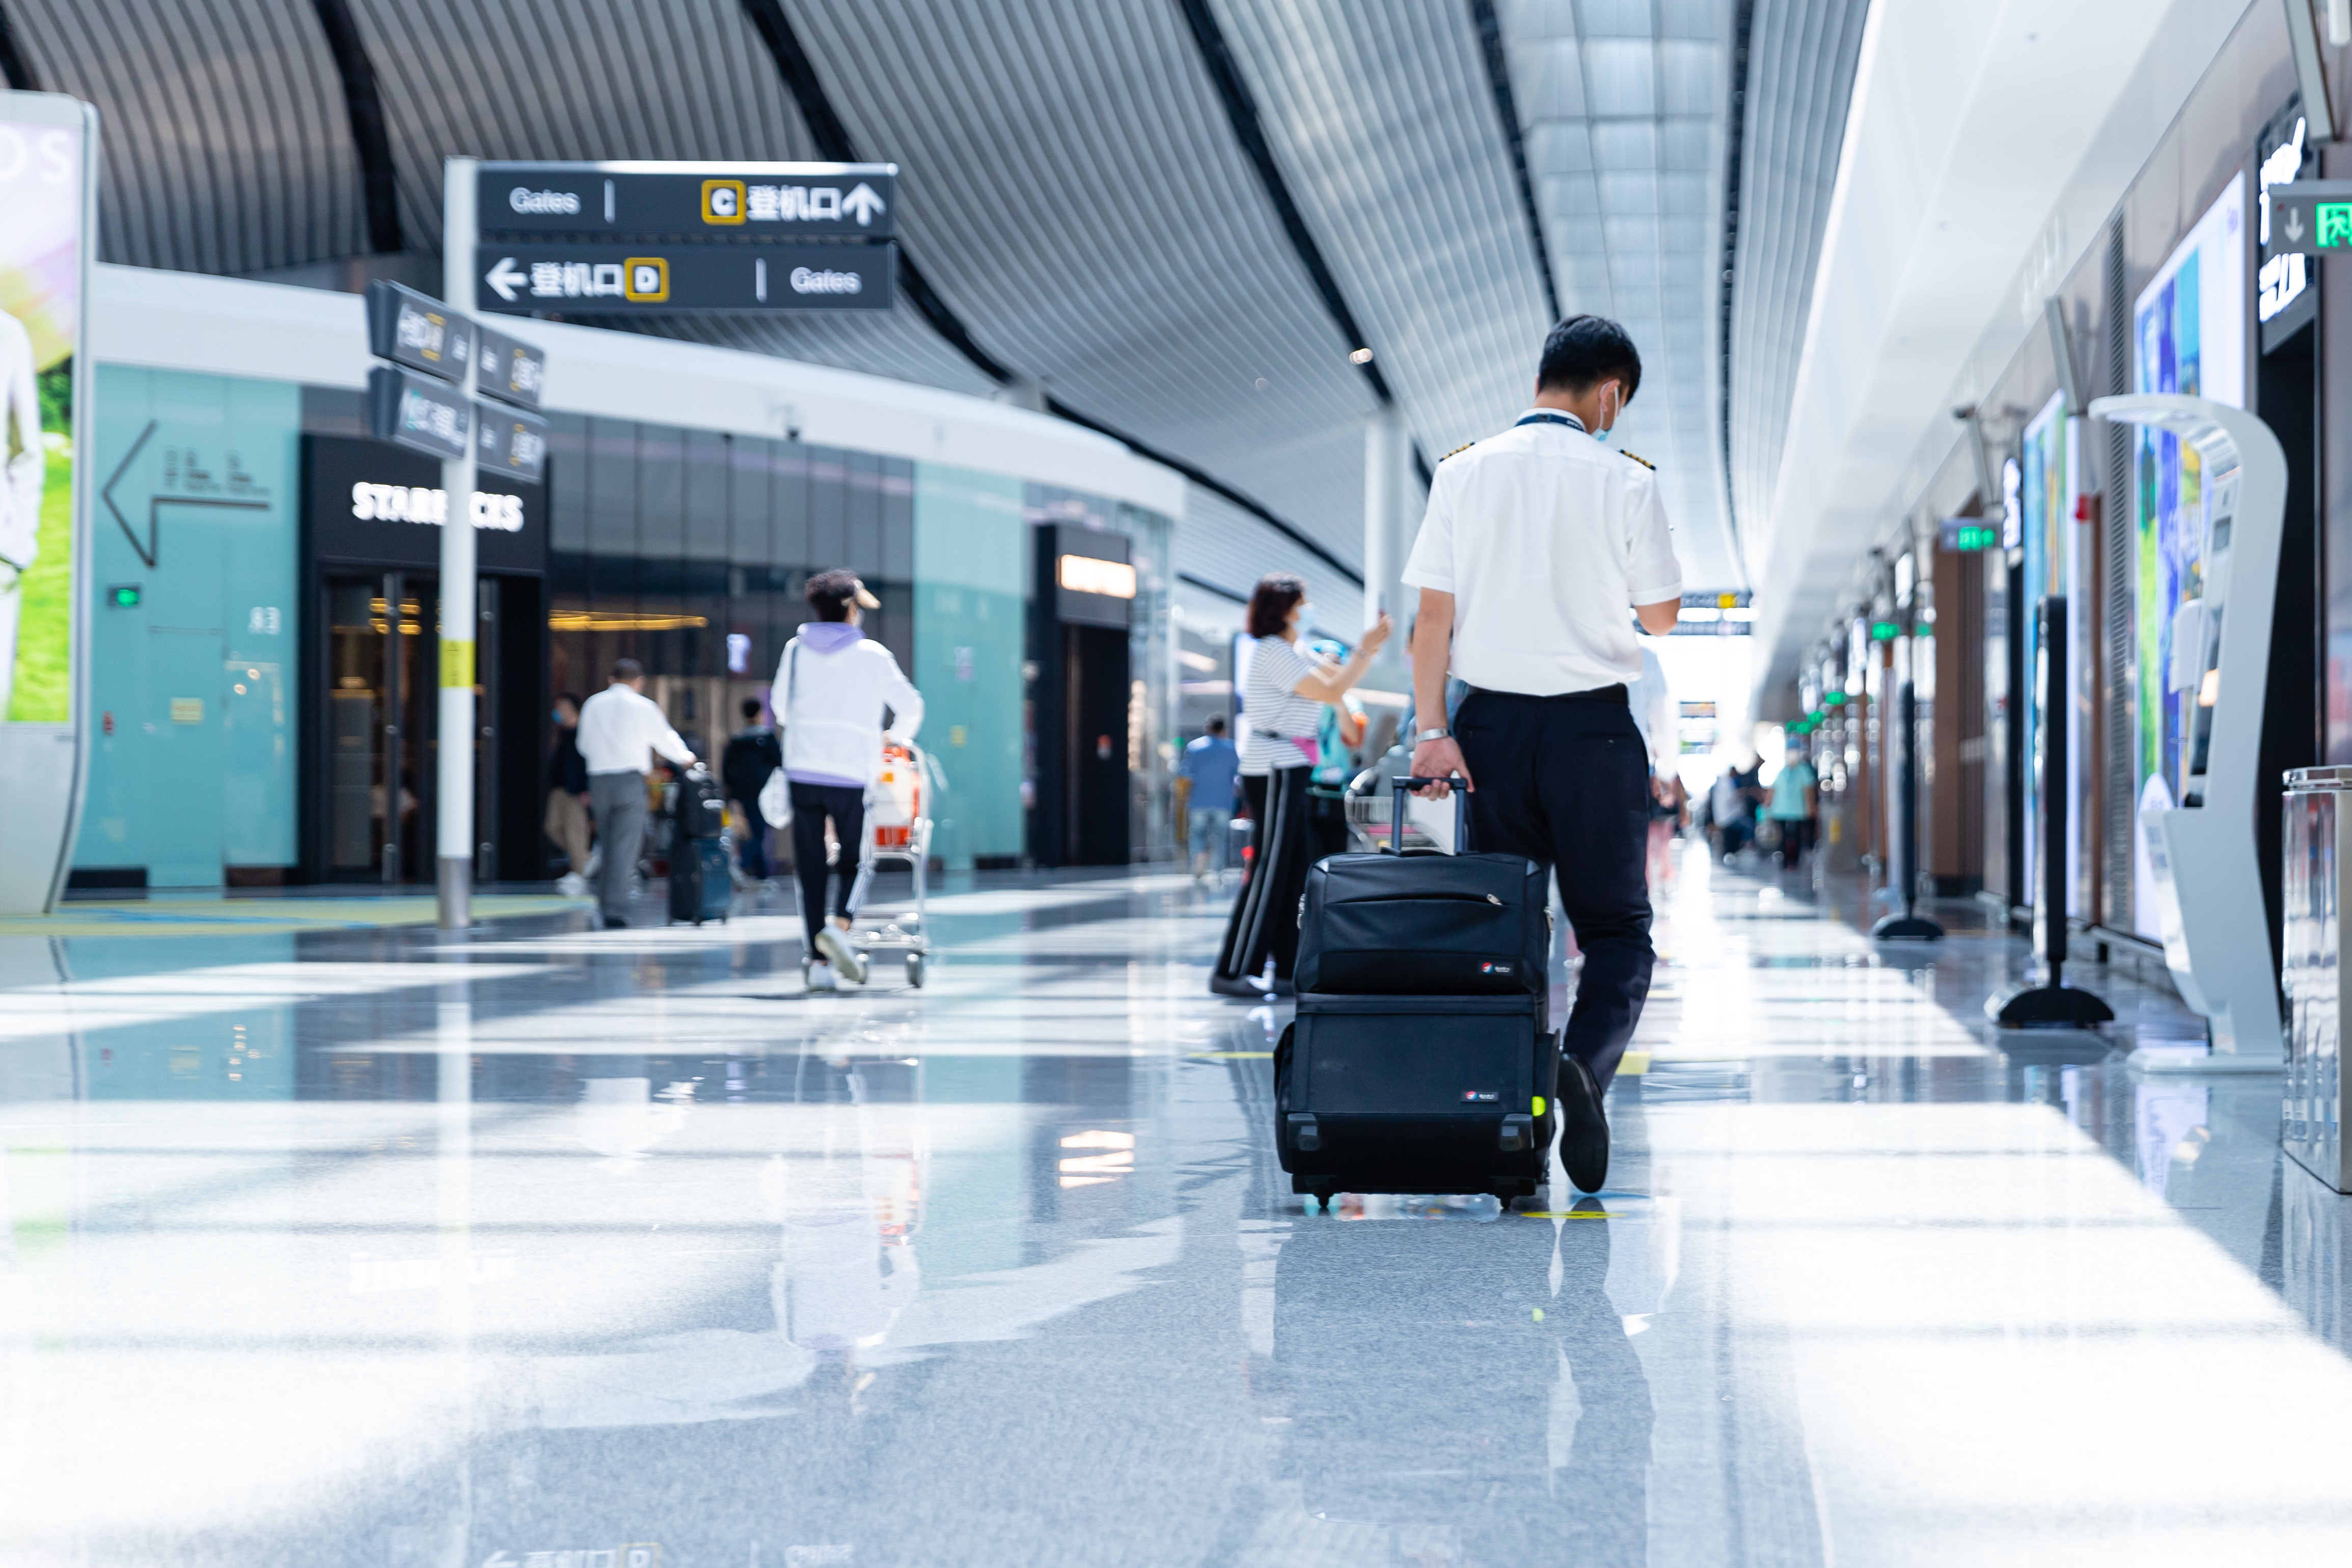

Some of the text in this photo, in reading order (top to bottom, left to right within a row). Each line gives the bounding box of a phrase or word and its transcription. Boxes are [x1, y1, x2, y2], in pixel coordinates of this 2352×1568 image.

[509, 186, 581, 215] Gates
[789, 266, 862, 295] Gates
[352, 481, 524, 532] STARBCKS
